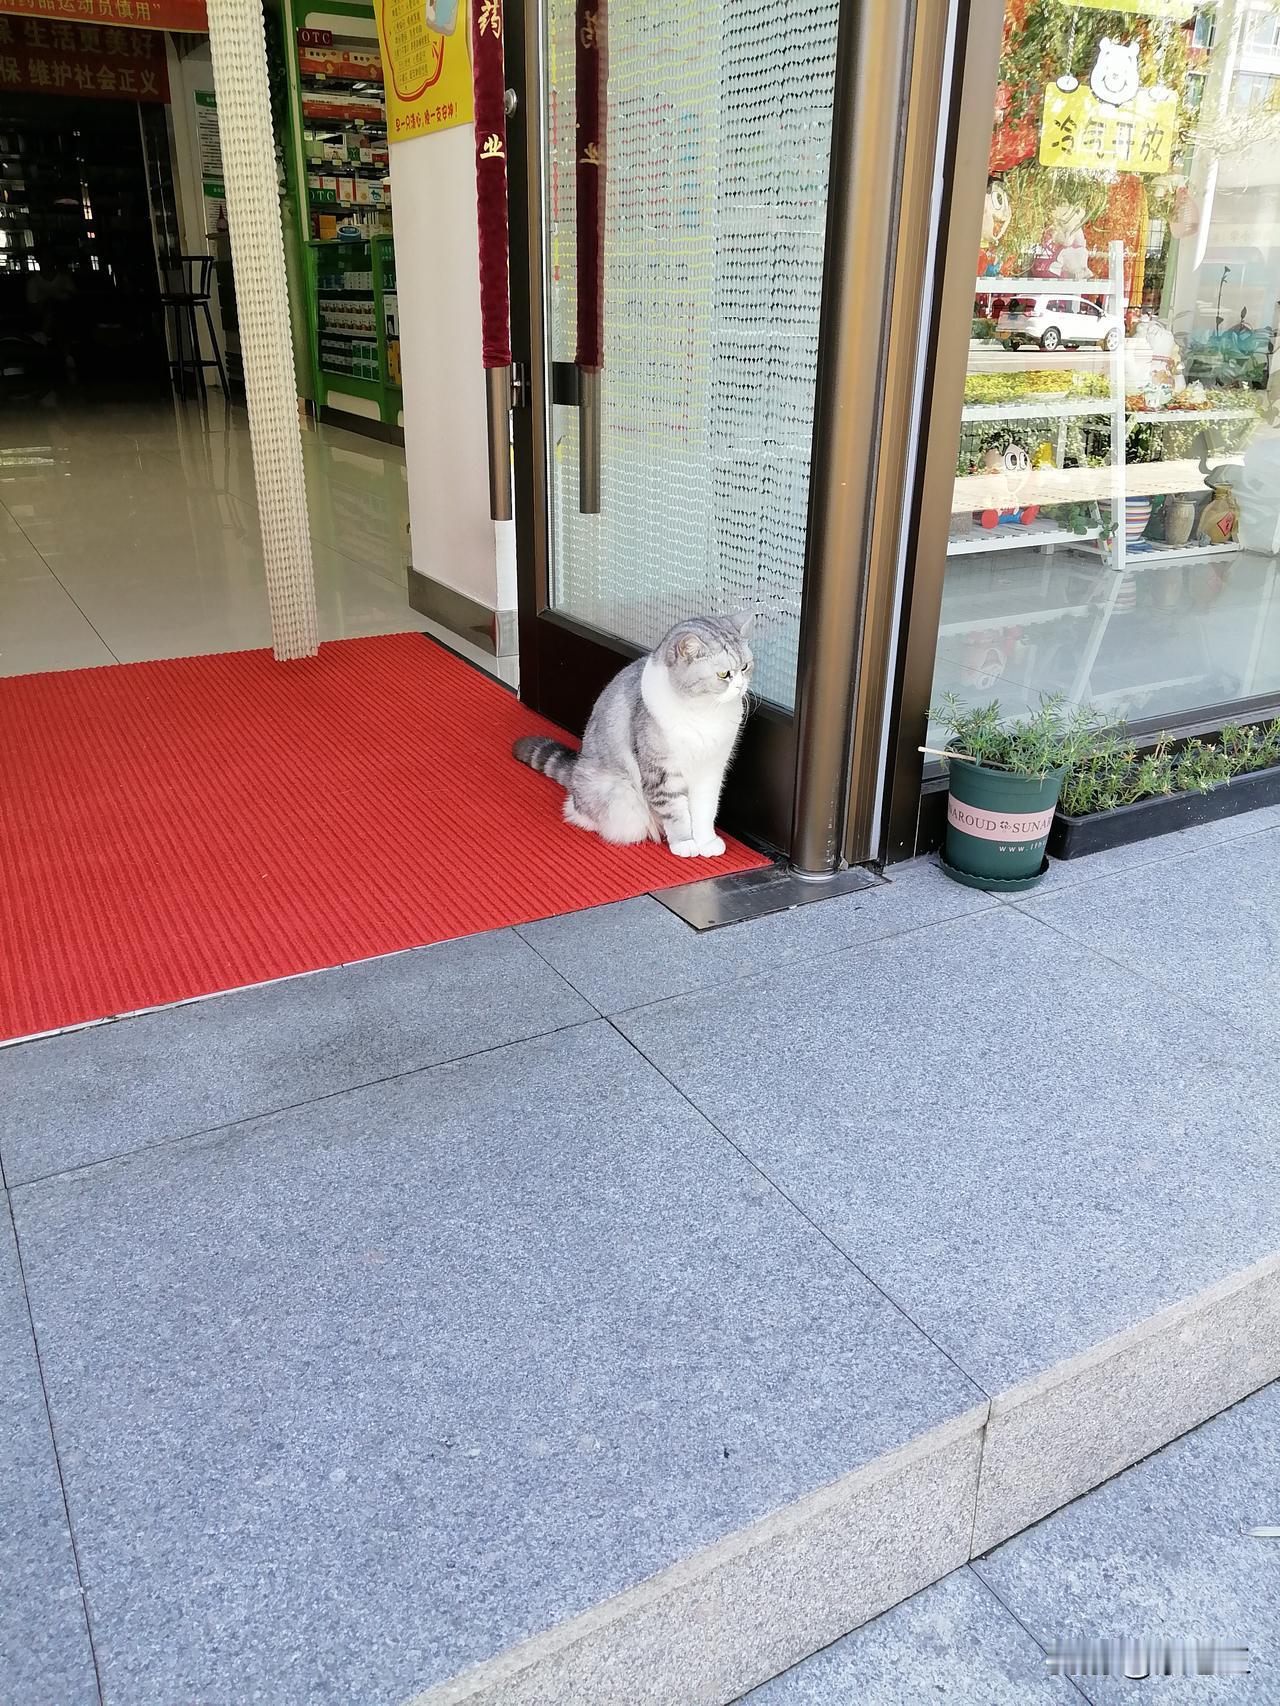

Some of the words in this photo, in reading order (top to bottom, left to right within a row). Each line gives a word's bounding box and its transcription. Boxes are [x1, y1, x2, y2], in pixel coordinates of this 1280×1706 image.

[24, 20, 153, 59] 生活更美好
[301, 31, 331, 45] OTC
[28, 57, 159, 96] 维护社会正义
